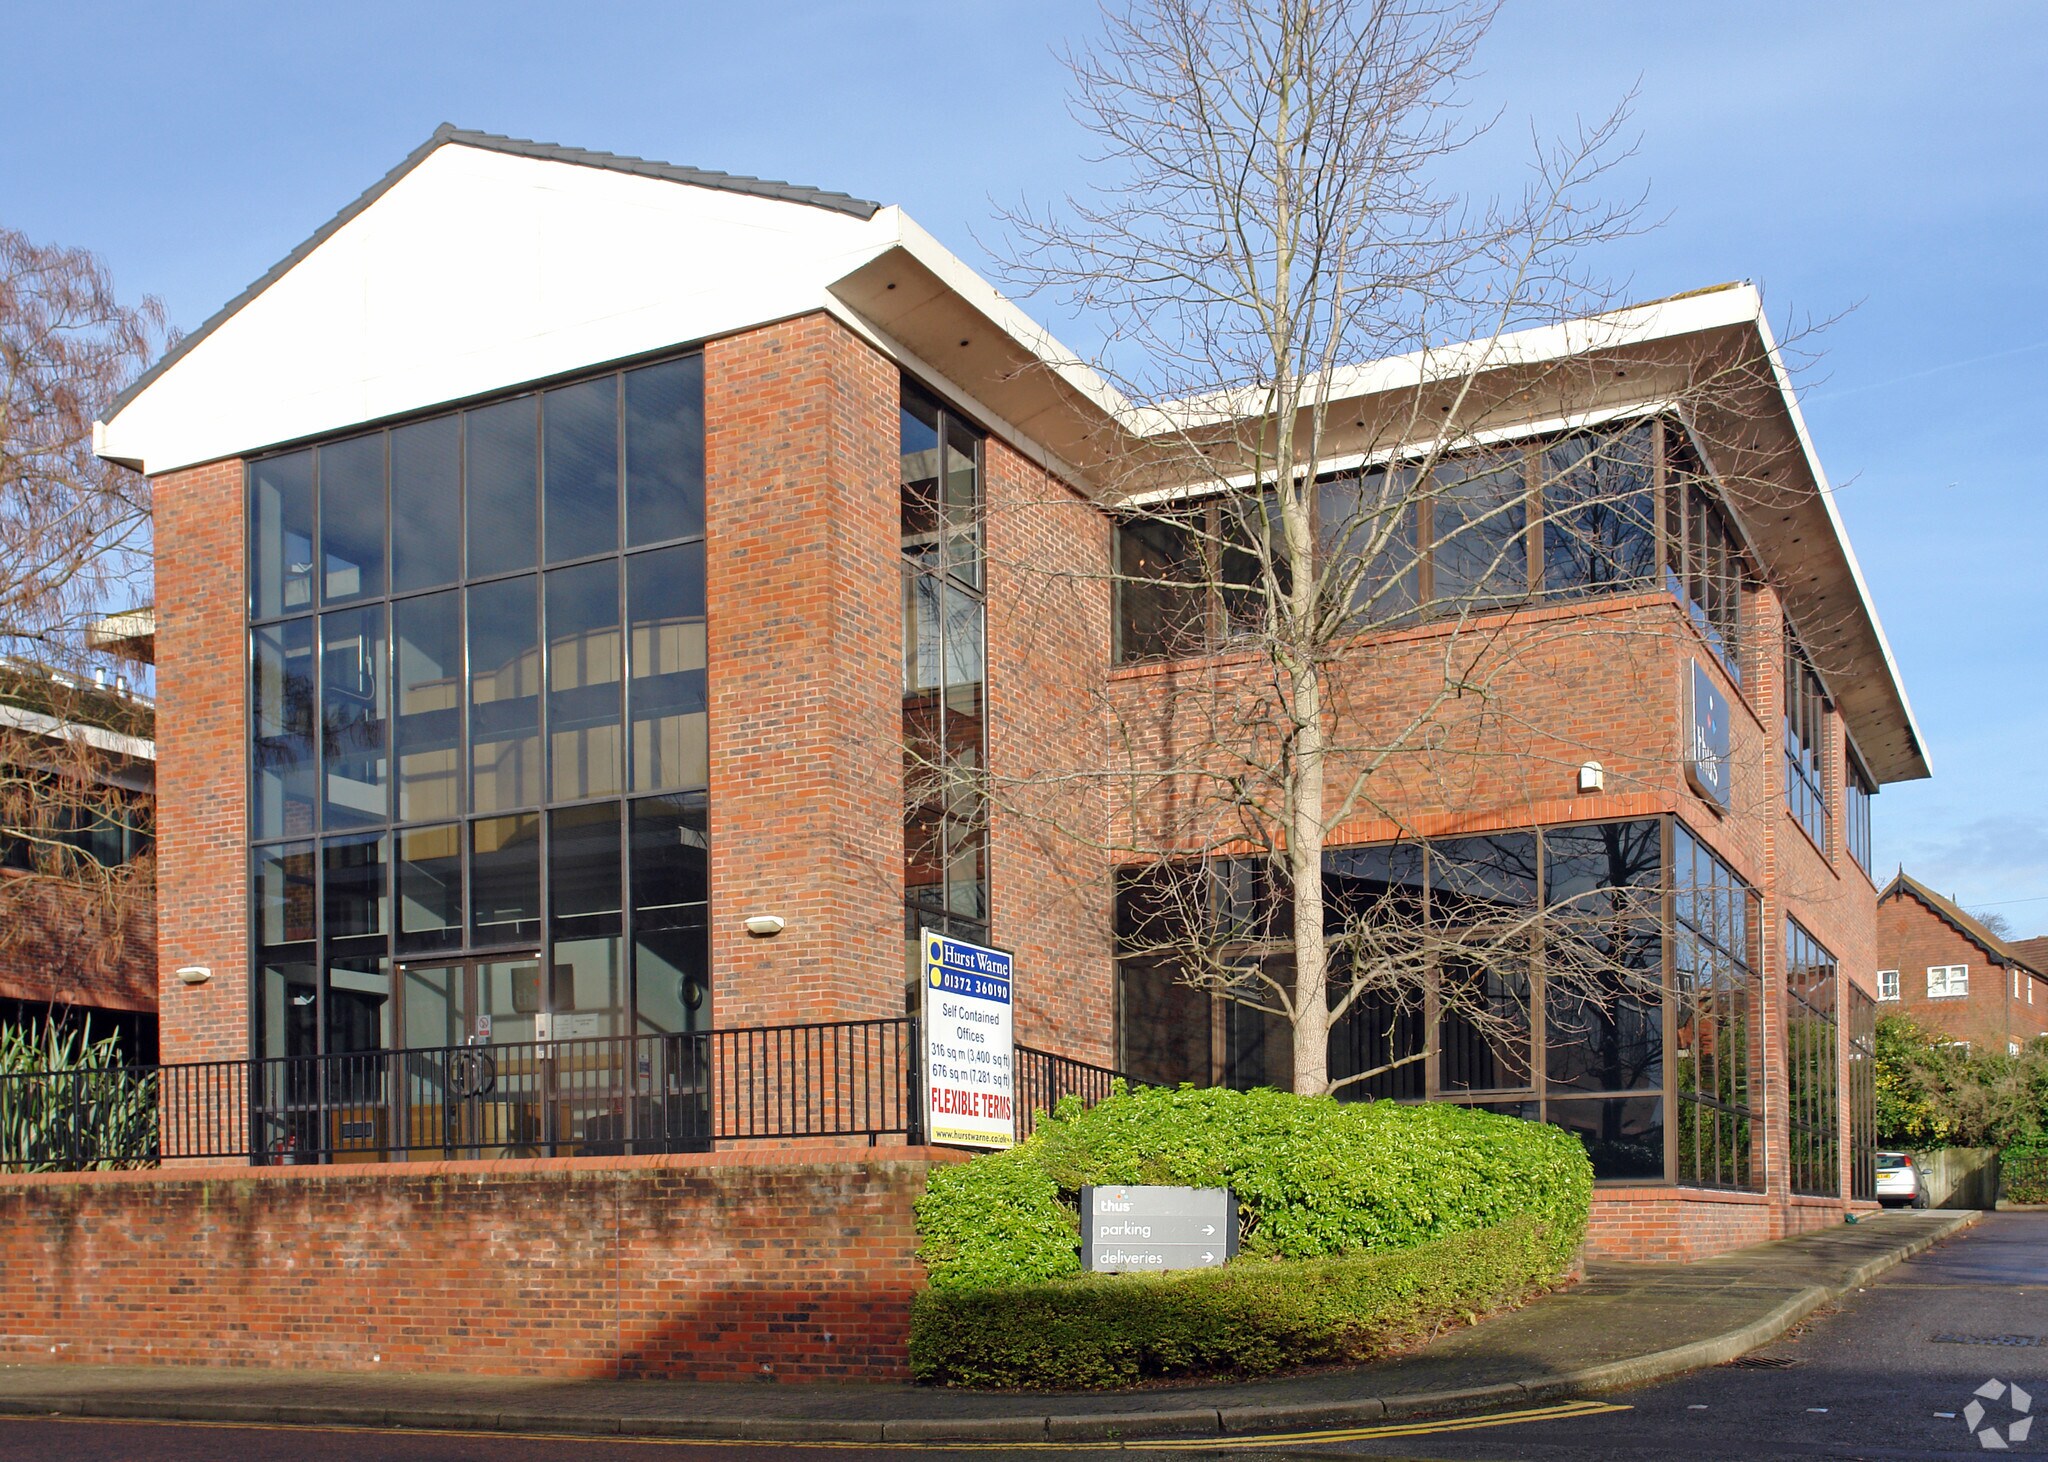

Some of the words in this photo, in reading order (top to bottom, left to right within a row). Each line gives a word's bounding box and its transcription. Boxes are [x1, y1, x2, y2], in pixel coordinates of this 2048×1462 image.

[1697, 725, 1718, 787] thus
[944, 944, 975, 968] Hurst
[976, 952, 1008, 976] Warne
[944, 973, 971, 992] 01372
[975, 980, 1008, 999] 360190
[942, 1002, 957, 1018] Self
[958, 1006, 1000, 1026] Contained
[956, 1026, 985, 1043] Offices
[931, 1042, 945, 1057] 316
[947, 1048, 957, 1062] sq
[958, 1050, 966, 1060] m
[967, 1048, 991, 1064] (3,400
[992, 1055, 1003, 1069] sq
[1003, 1053, 1011, 1070] ft)
[932, 1063, 948, 1078] 676
[949, 1068, 960, 1083] sq
[960, 1070, 969, 1081] m
[992, 1075, 1003, 1089] sq
[1003, 1073, 1011, 1090] ft)
[931, 1087, 979, 1117] FLEXIBLE
[982, 1093, 1011, 1121] TERMS
[1100, 1200, 1131, 1212] thus
[1100, 1221, 1151, 1238] parking
[1100, 1250, 1163, 1264] deliveries
